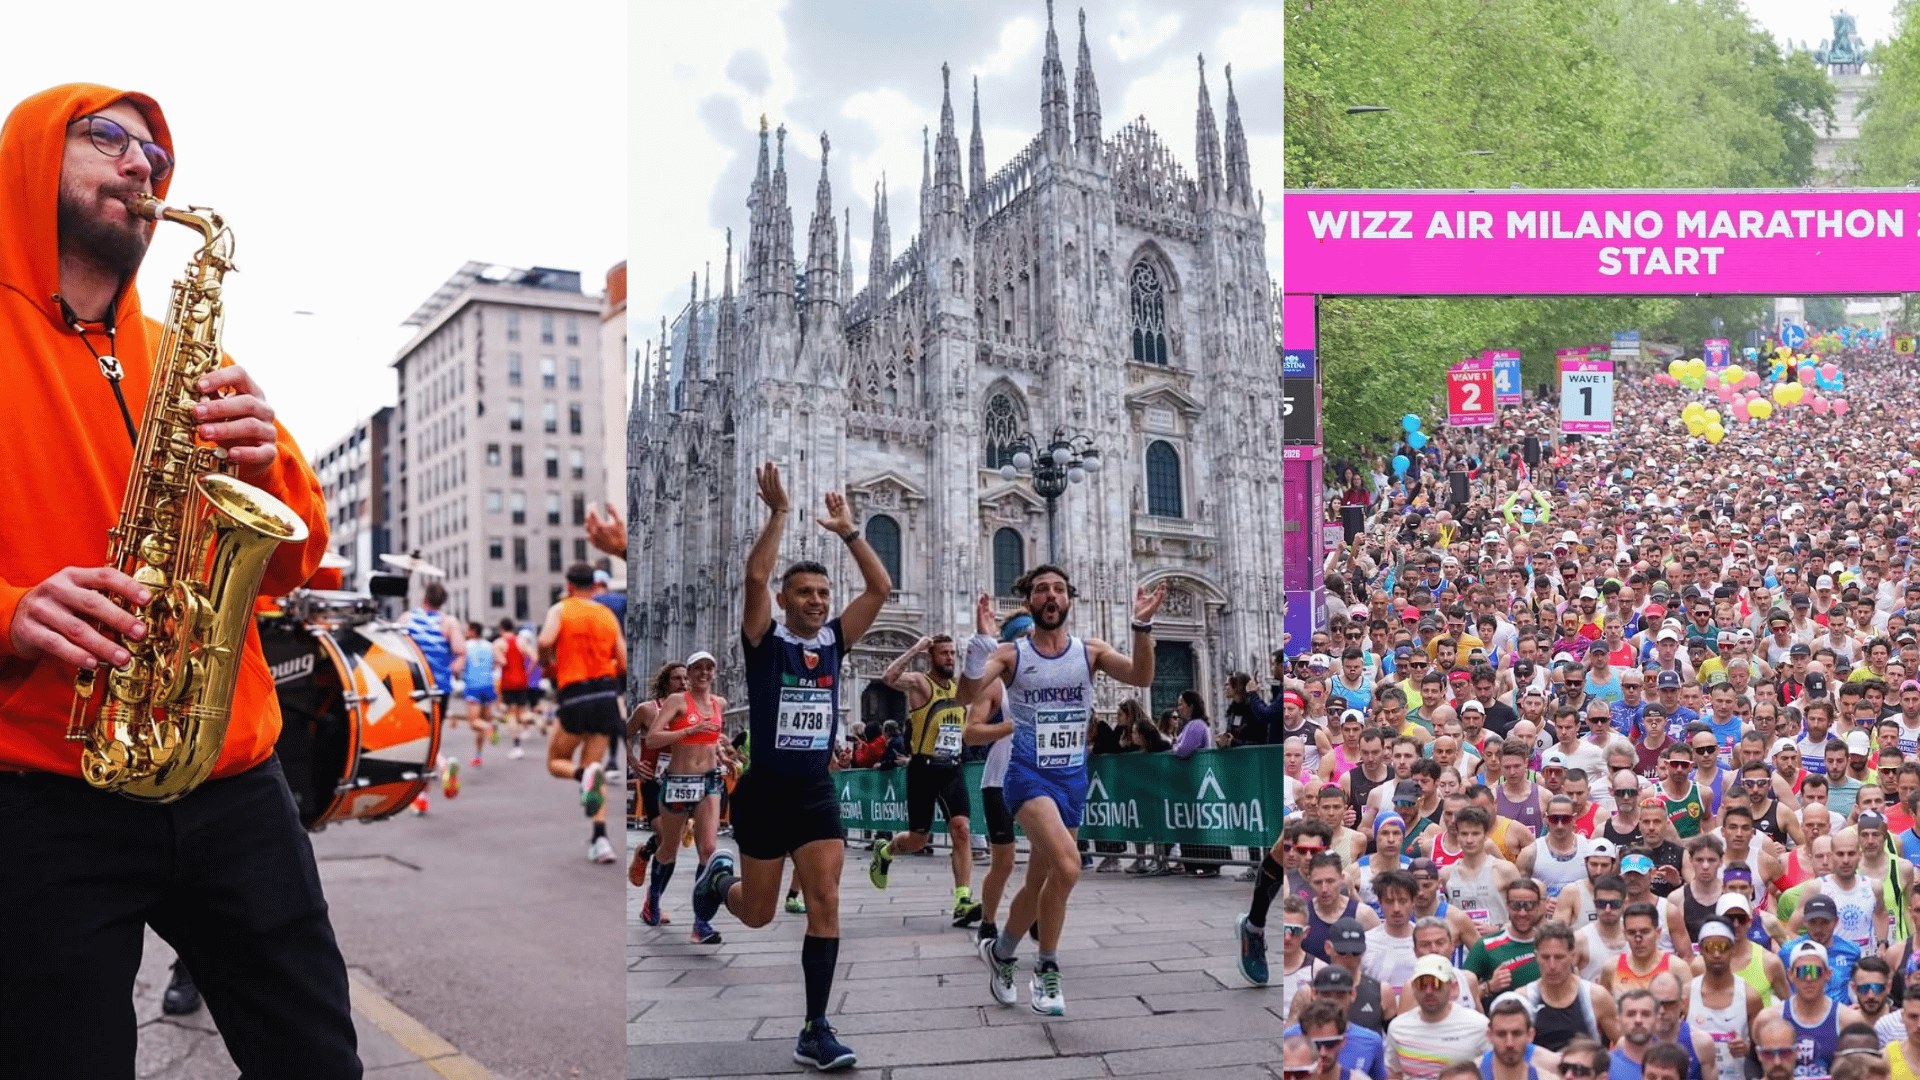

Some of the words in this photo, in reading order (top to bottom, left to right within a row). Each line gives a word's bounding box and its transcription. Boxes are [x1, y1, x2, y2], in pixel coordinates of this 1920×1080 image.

[1307, 210, 1413, 239] WIZZ
[1425, 210, 1494, 239] AIR
[1507, 209, 1664, 239] MILANO
[1676, 208, 1904, 239] MARATHON
[1598, 245, 1725, 276] START
[1494, 360, 1511, 368] AVE
[1451, 372, 1481, 382] WAVE
[1482, 372, 1487, 380] 1
[1495, 369, 1512, 392] 4
[1569, 375, 1600, 383] WAVE
[1602, 375, 1606, 383] 1
[1461, 383, 1482, 411] 2
[1579, 386, 1592, 416] 1
[1284, 449, 1301, 459] 2026
[792, 712, 823, 730] 4738
[1050, 727, 1077, 749] 4574
[1164, 798, 1264, 832] LEVISSIMA
